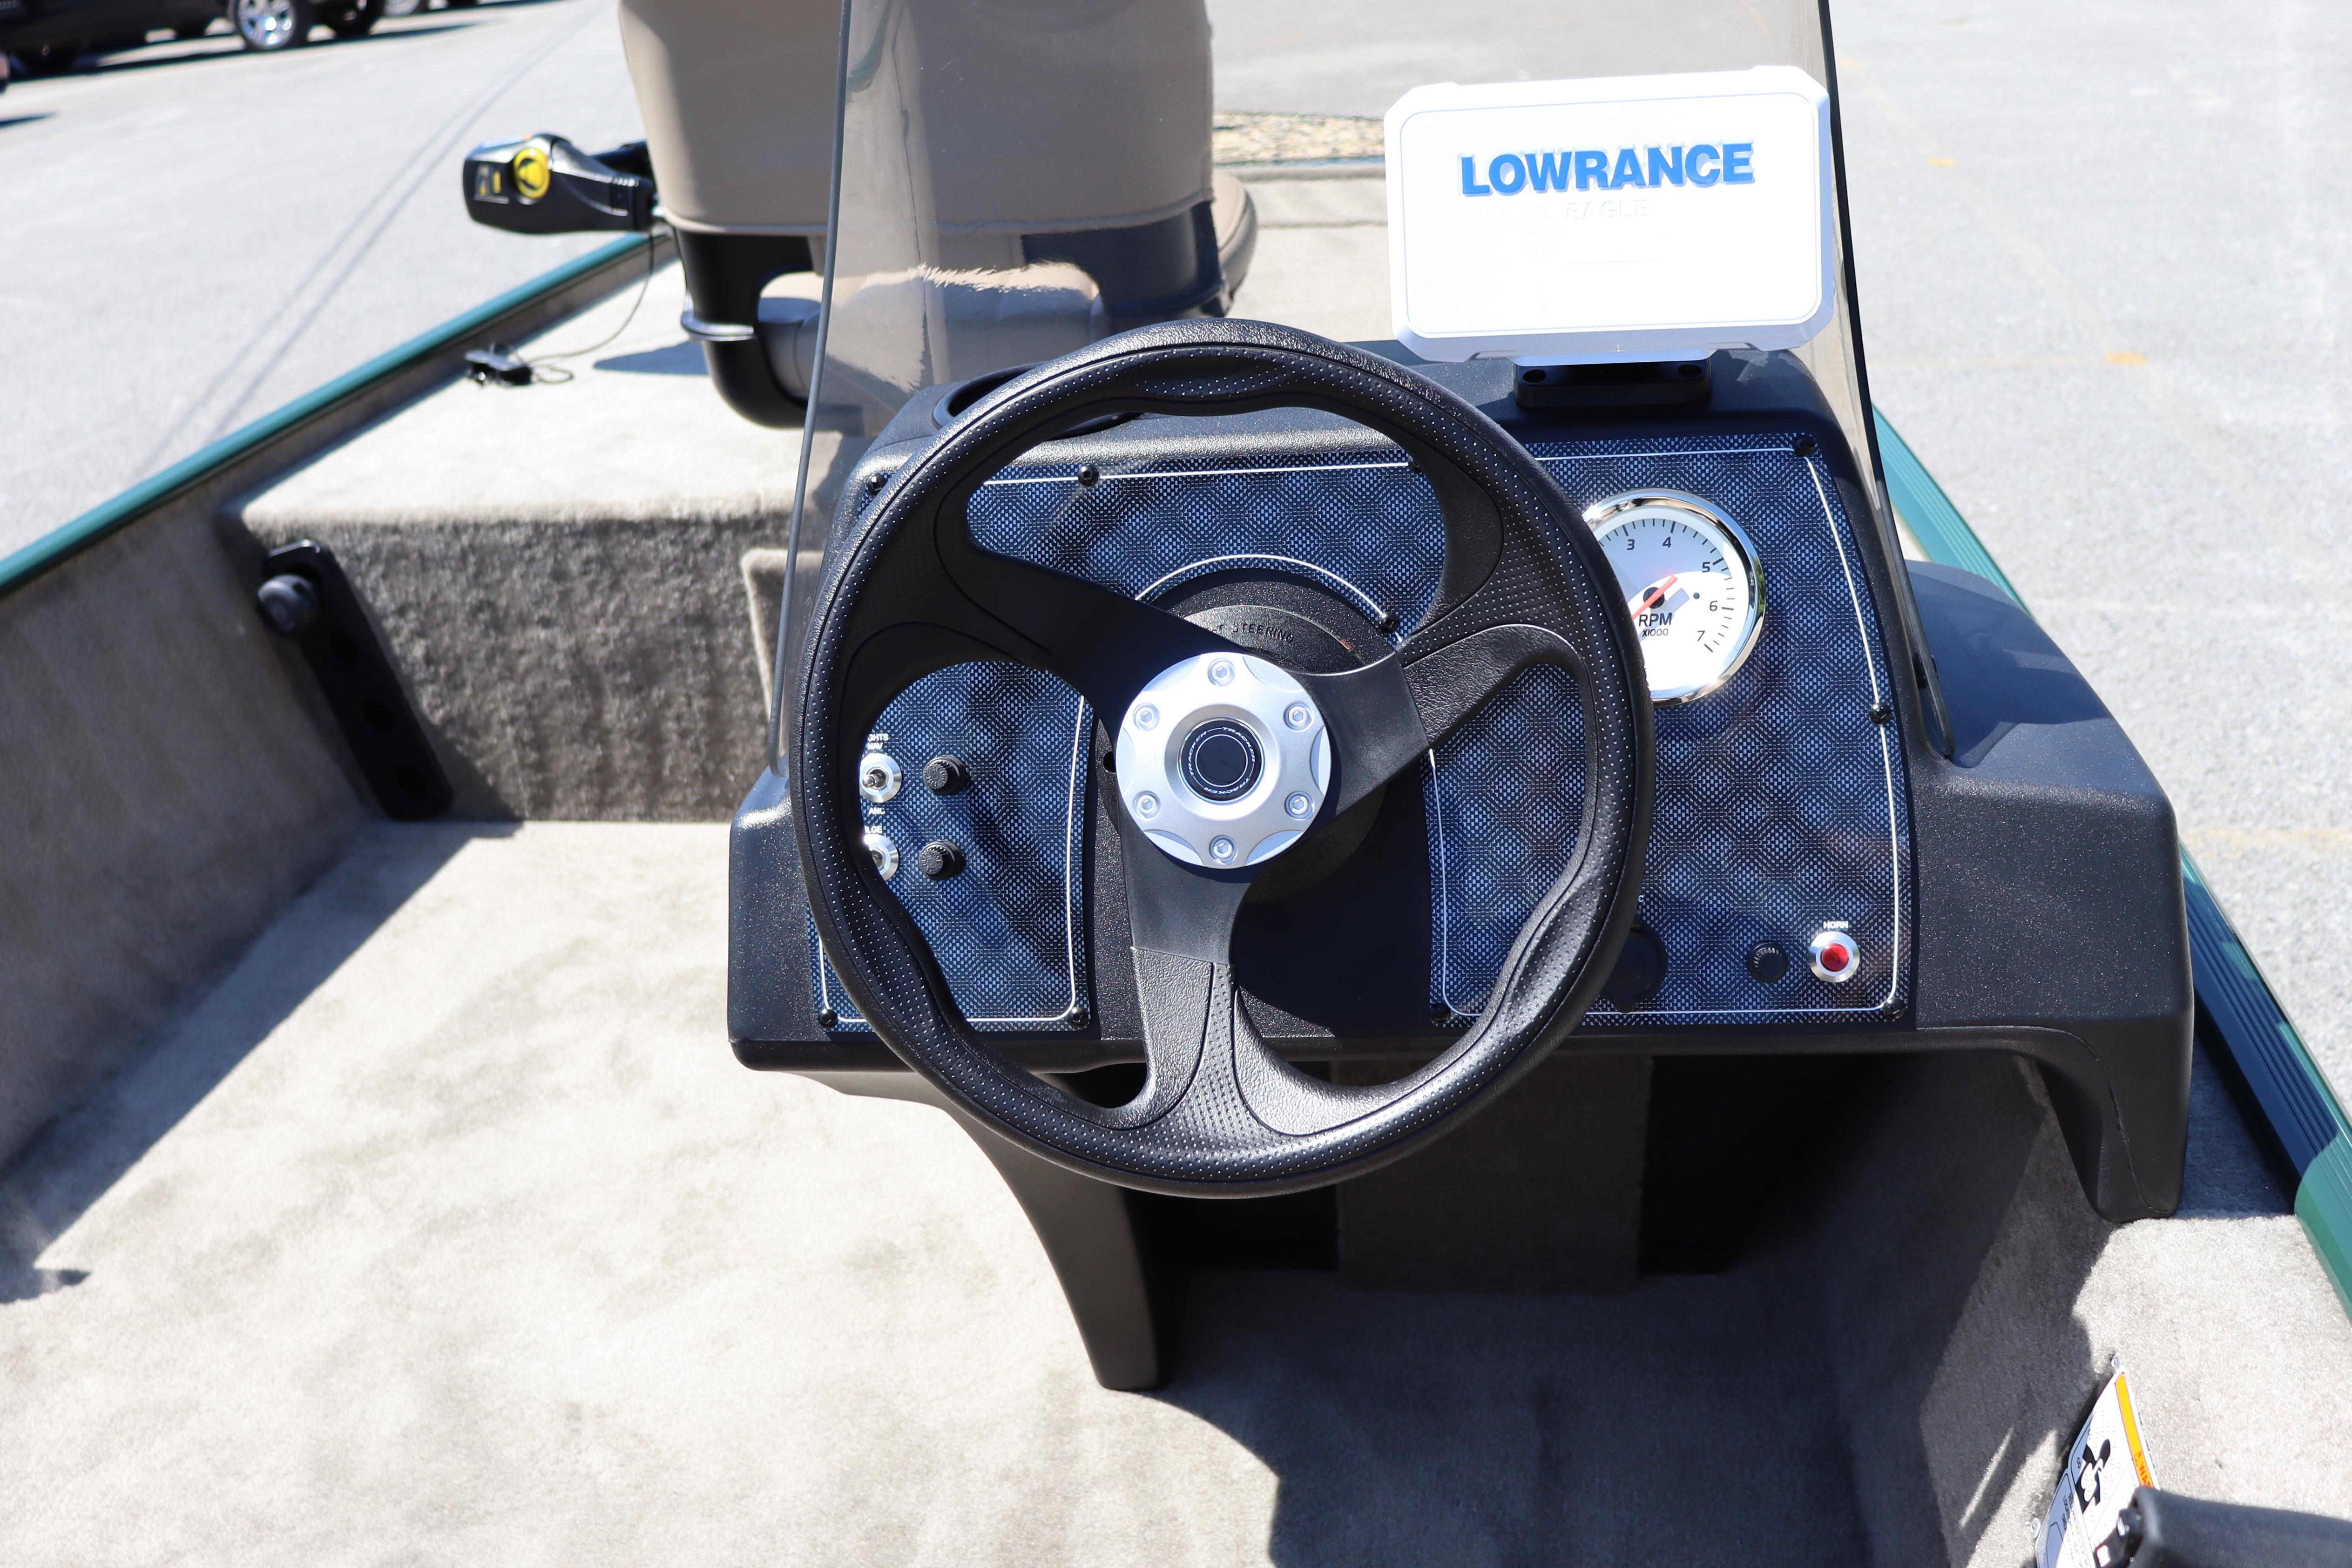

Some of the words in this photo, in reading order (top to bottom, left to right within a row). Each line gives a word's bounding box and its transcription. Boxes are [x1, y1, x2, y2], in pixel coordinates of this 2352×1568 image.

[1460, 141, 1755, 196] LOWRANCE
[1566, 199, 1649, 221] EAGLE
[1627, 539, 1635, 551] 3
[1662, 537, 1672, 548] 4
[1702, 561, 1711, 573] 5
[1710, 600, 1718, 612] 6
[1639, 613, 1672, 627] RPM
[1233, 622, 1294, 643] STEERING
[1697, 630, 1705, 642] 7
[1223, 727, 1255, 763] TRACKER
[1188, 731, 1207, 777] TRACKER
[1203, 778, 1250, 794] TRACKER
